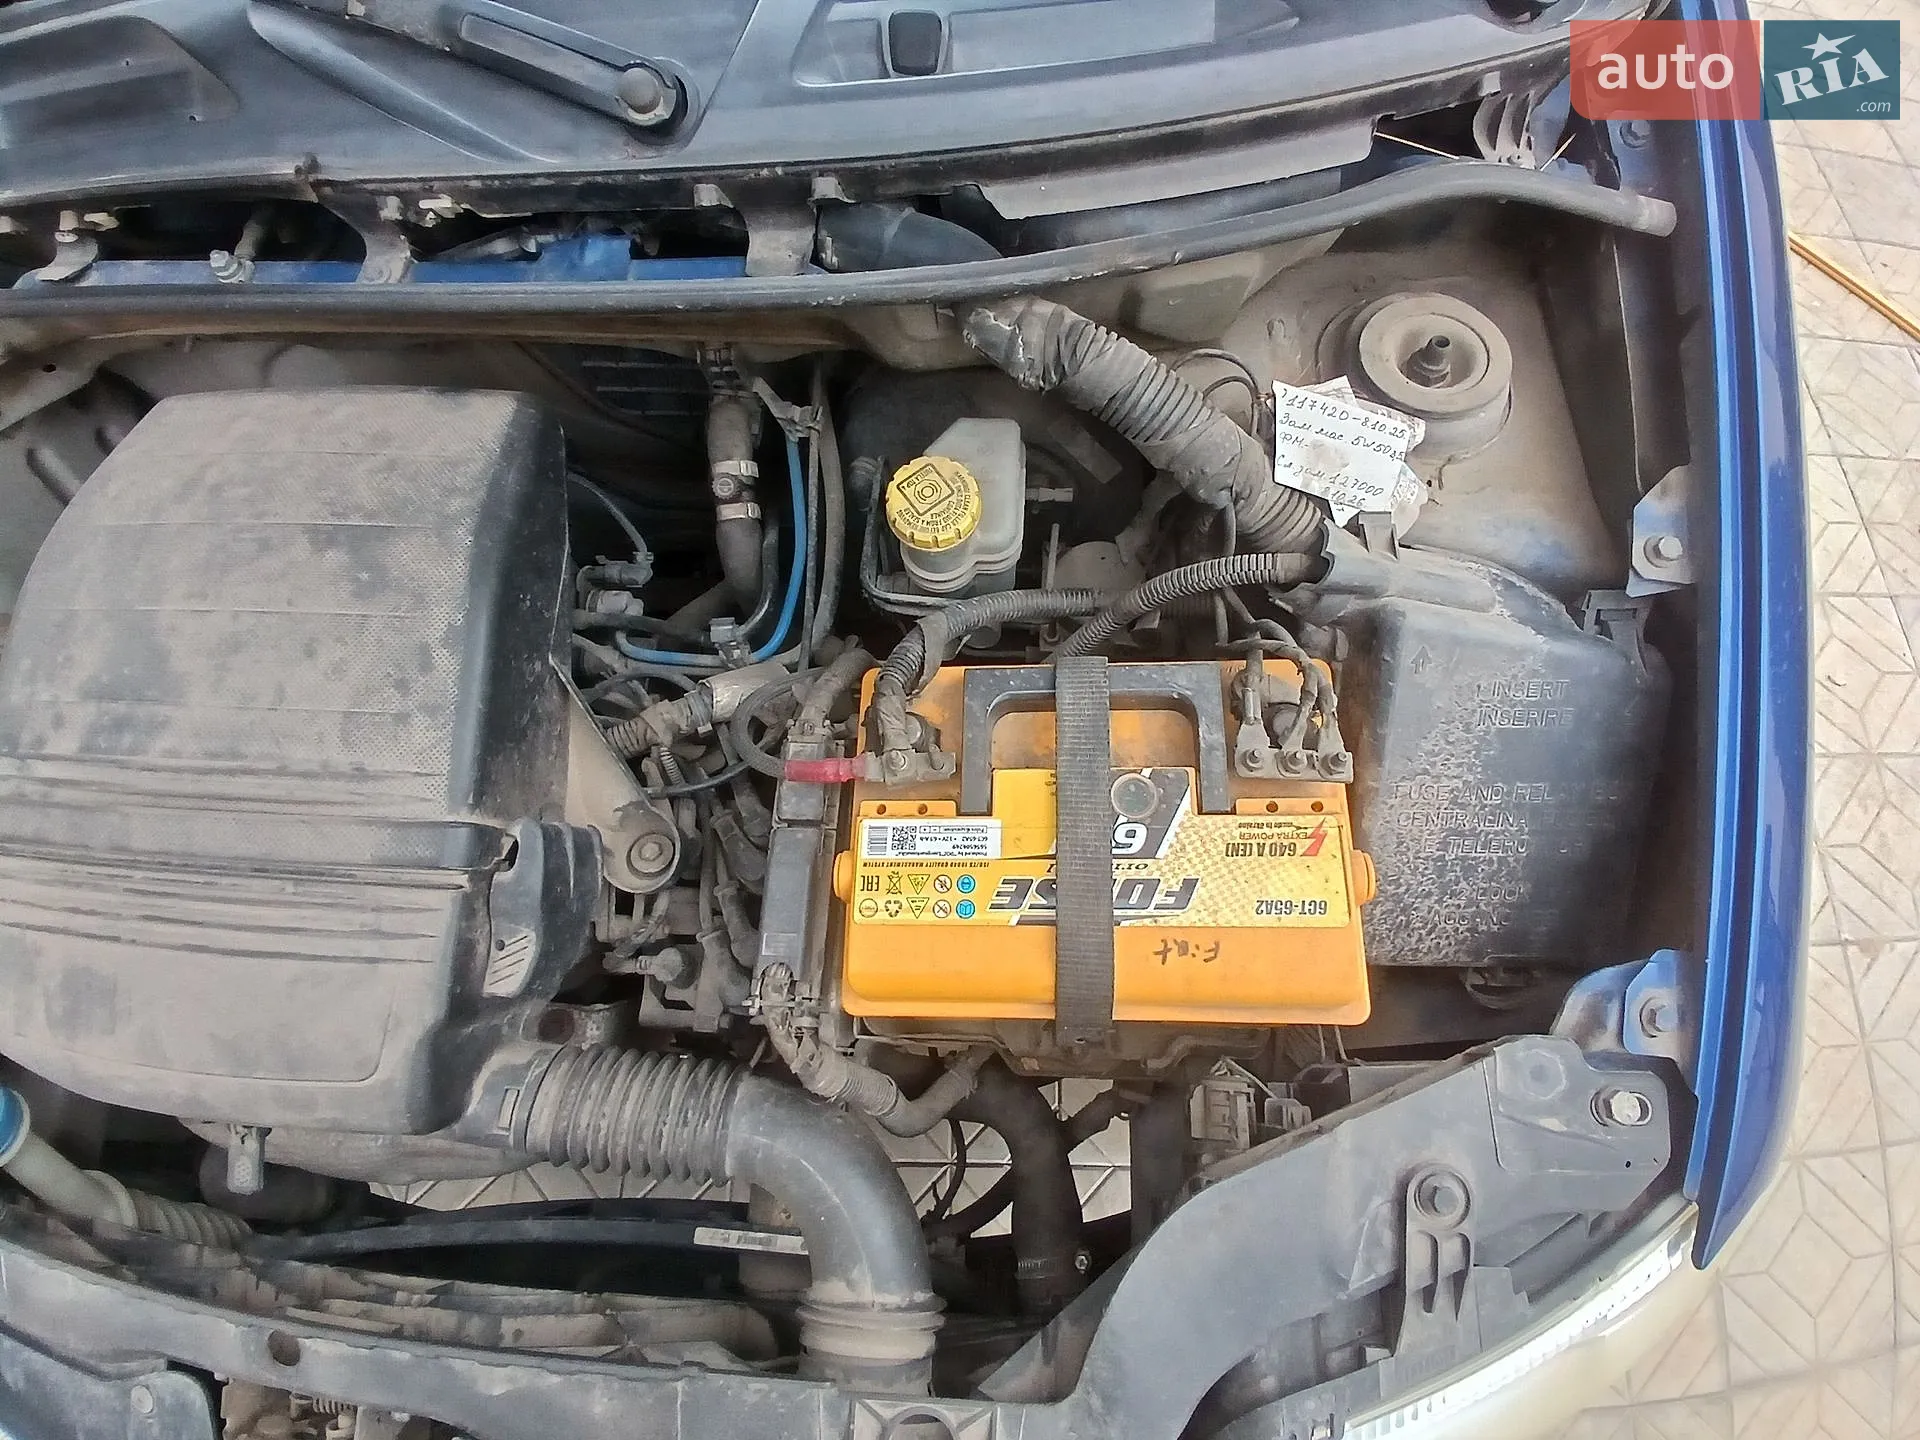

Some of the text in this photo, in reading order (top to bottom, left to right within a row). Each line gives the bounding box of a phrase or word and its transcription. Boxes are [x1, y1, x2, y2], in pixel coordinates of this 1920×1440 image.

[1491, 679, 1571, 699] INSERT
[1477, 707, 1576, 728] INSERIRE
[1458, 782, 1505, 803] AND
[1239, 831, 1308, 840] EXTRA POWER
[1255, 842, 1267, 858] A
[1268, 842, 1297, 858] 640
[987, 877, 1200, 911] FOSE
[1254, 899, 1328, 916] 6CT-65A2
